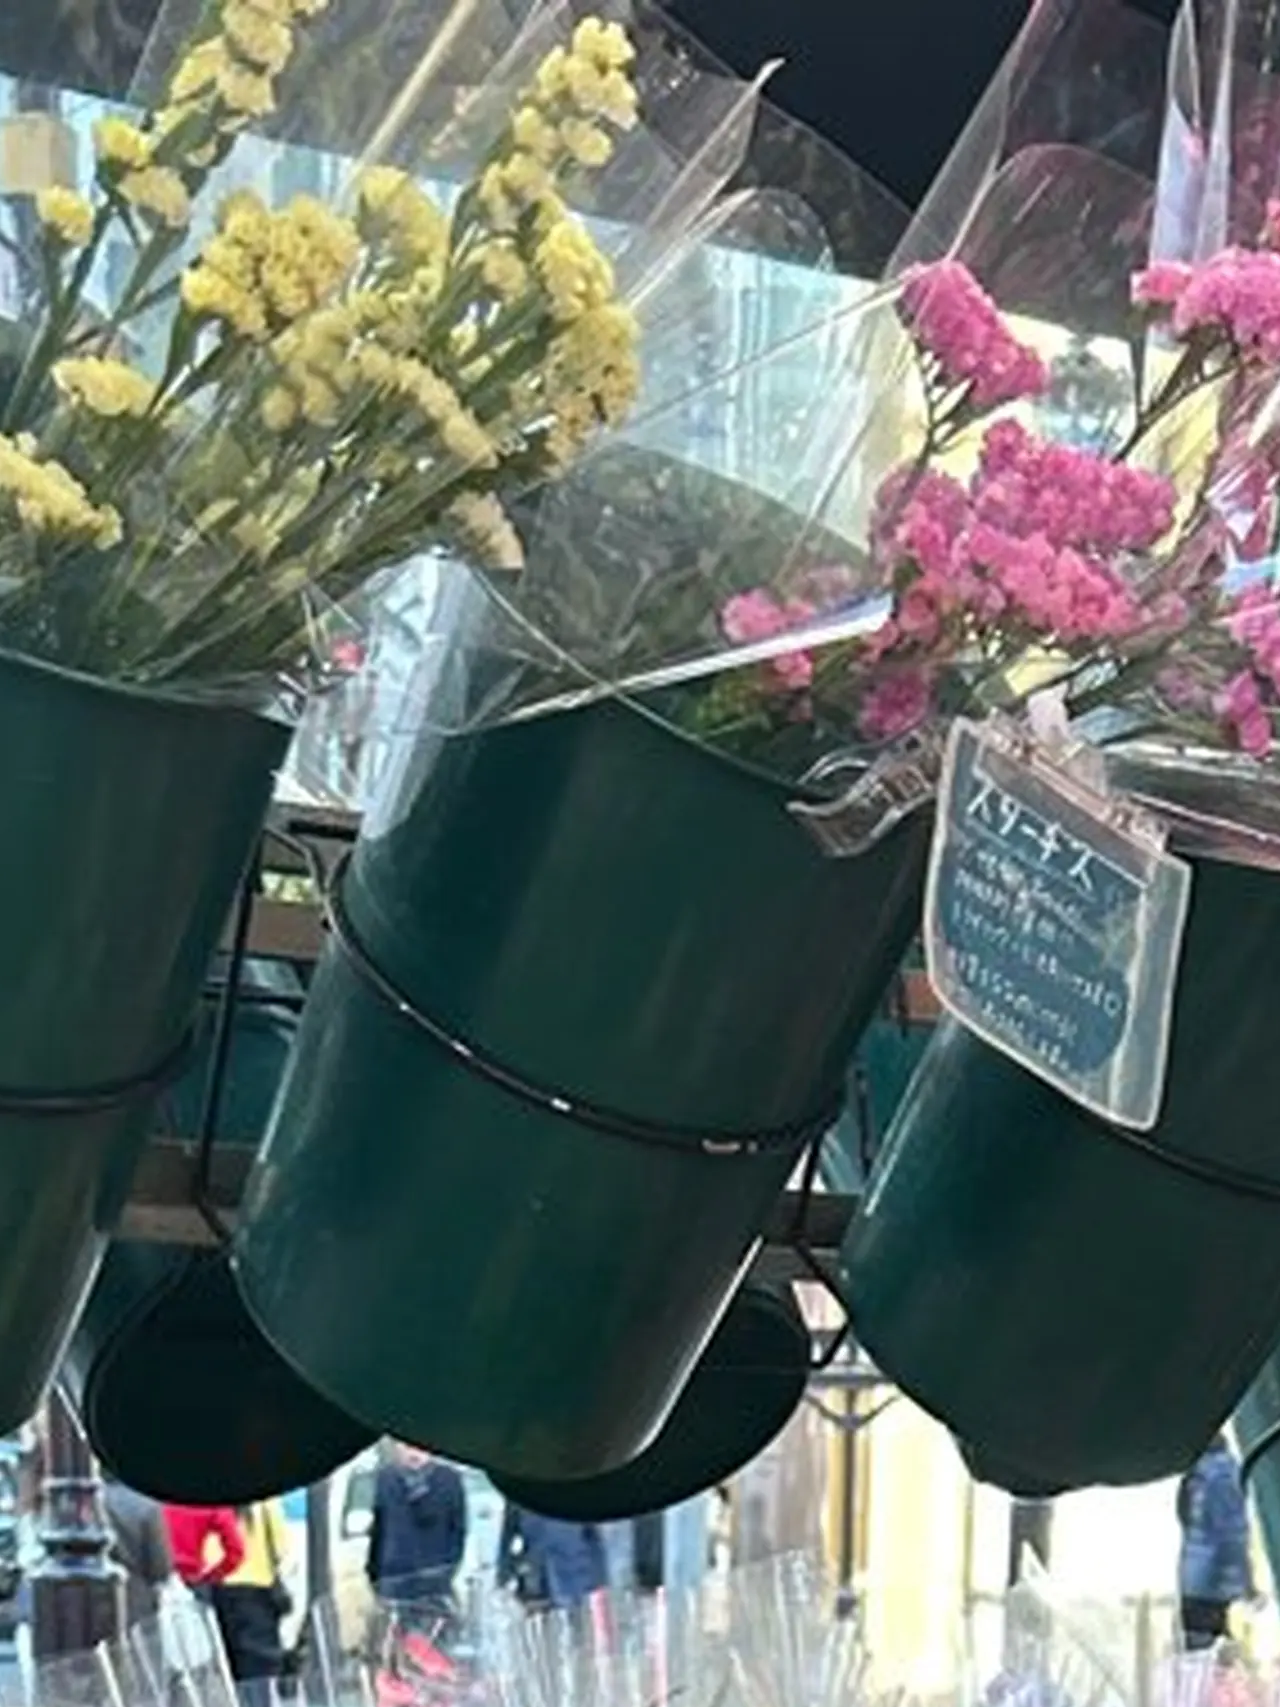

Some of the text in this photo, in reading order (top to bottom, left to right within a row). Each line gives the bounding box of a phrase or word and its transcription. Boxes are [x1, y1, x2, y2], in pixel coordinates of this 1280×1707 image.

[967, 782, 1093, 892] スターチス
